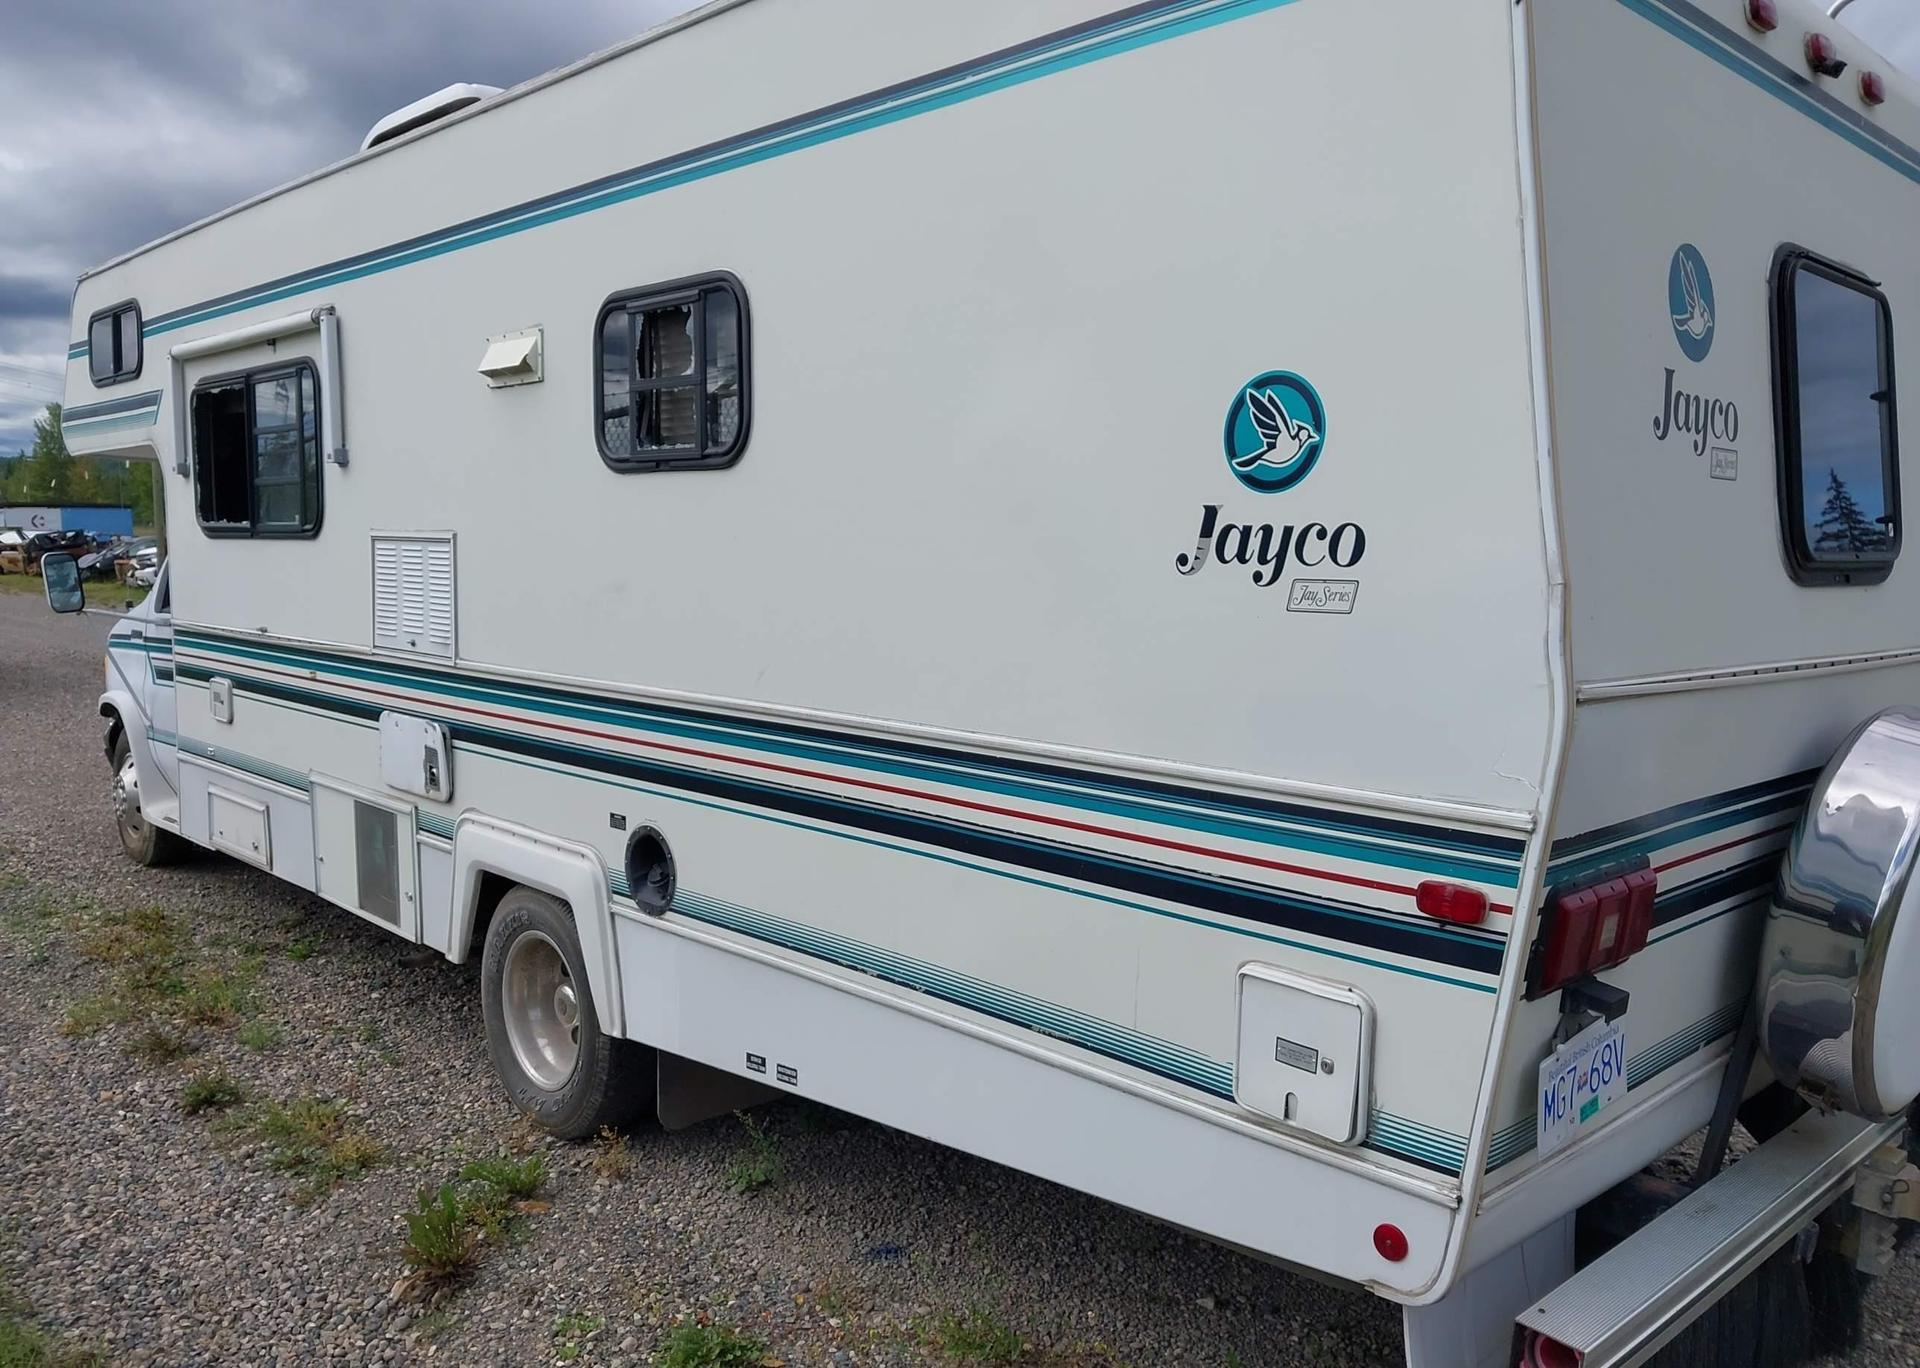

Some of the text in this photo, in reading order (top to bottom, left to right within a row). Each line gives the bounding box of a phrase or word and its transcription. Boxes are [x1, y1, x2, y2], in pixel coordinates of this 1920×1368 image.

[1653, 367, 1739, 456] Jayco
[1176, 504, 1366, 587] Jayco
[1292, 584, 1351, 607] Jay Series
